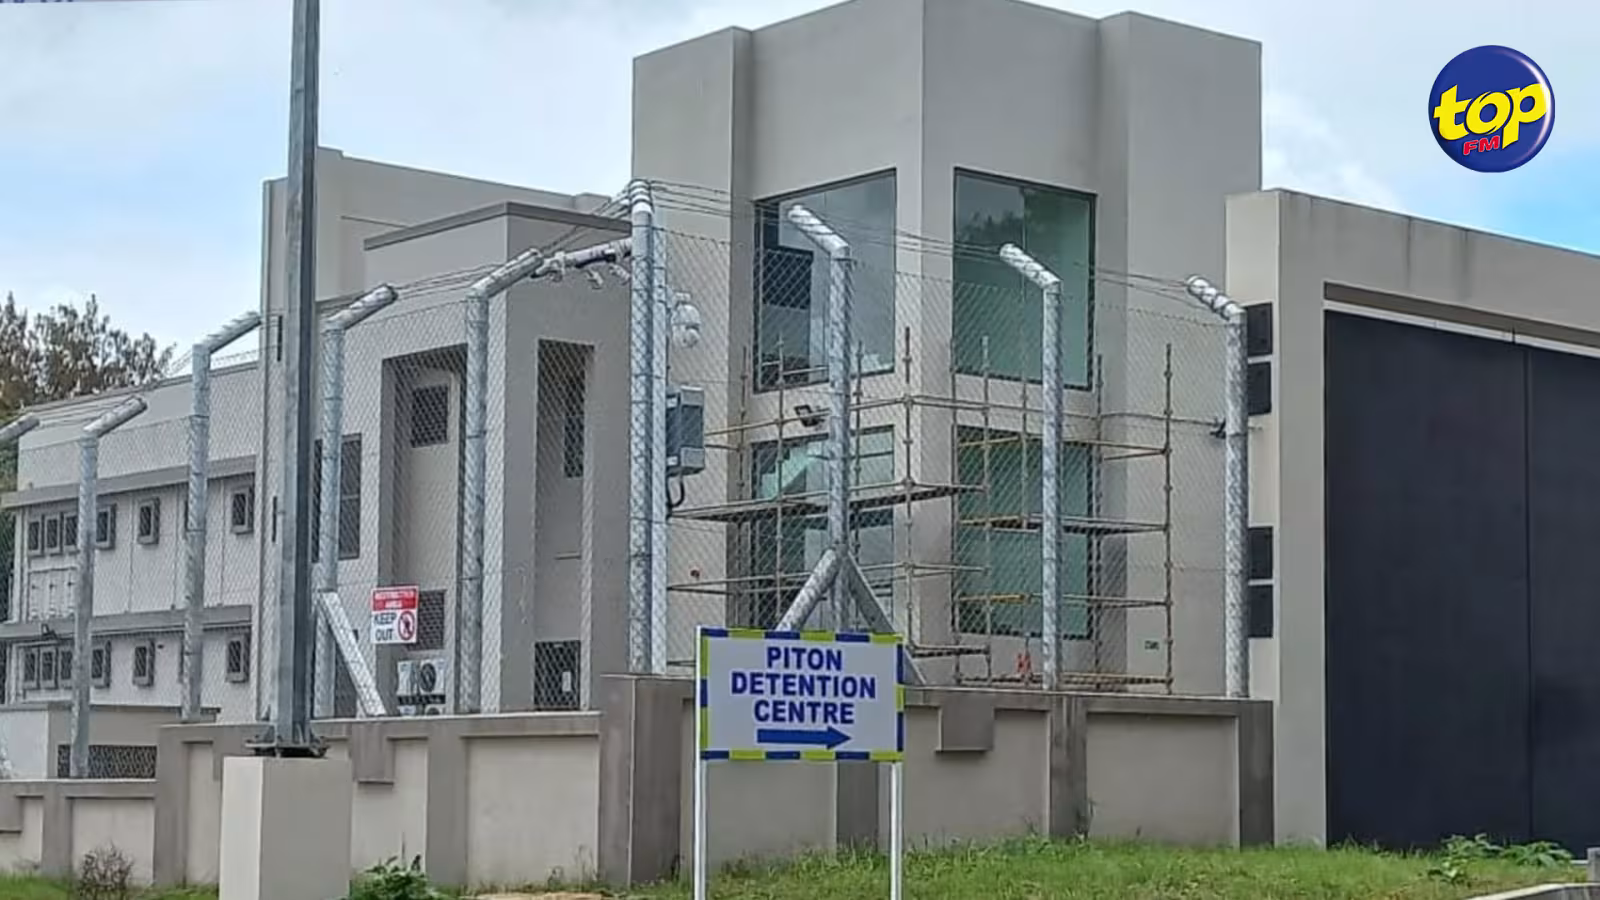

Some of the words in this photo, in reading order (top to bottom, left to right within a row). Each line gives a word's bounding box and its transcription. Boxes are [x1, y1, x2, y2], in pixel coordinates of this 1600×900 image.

[373, 612, 397, 625] KEEP
[375, 628, 393, 641] OUT
[766, 646, 843, 671] PITON
[731, 671, 876, 699] DETENTION
[754, 699, 855, 724] CENTRE
